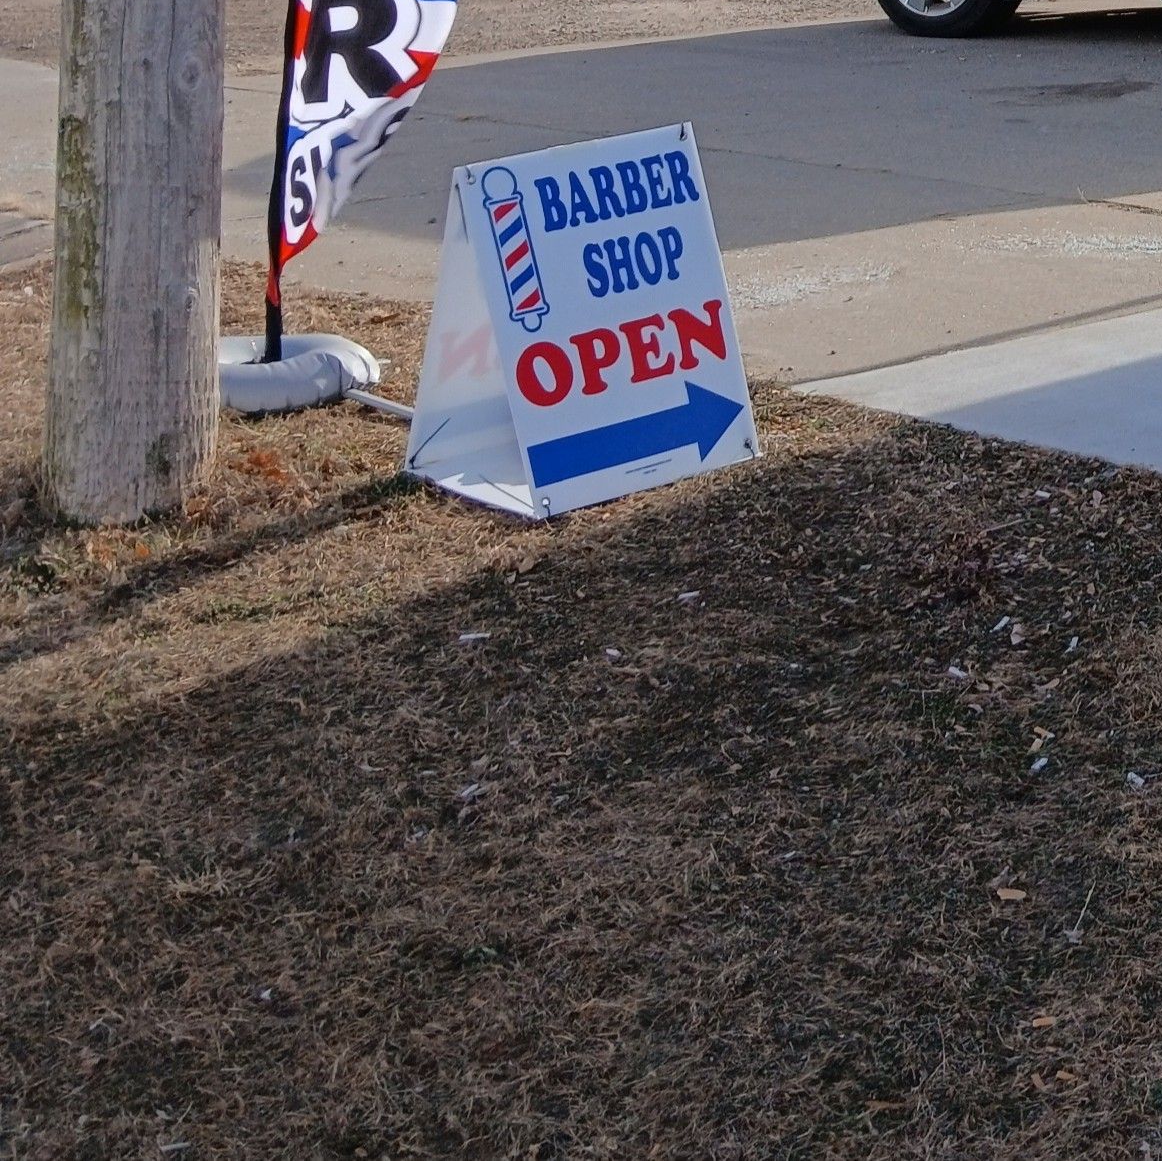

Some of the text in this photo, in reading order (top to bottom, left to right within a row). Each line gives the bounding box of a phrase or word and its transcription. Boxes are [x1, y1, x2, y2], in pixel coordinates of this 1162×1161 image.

[533, 149, 701, 233] BARBER
[582, 225, 685, 298] SHOP
[515, 298, 727, 407] OPEN
